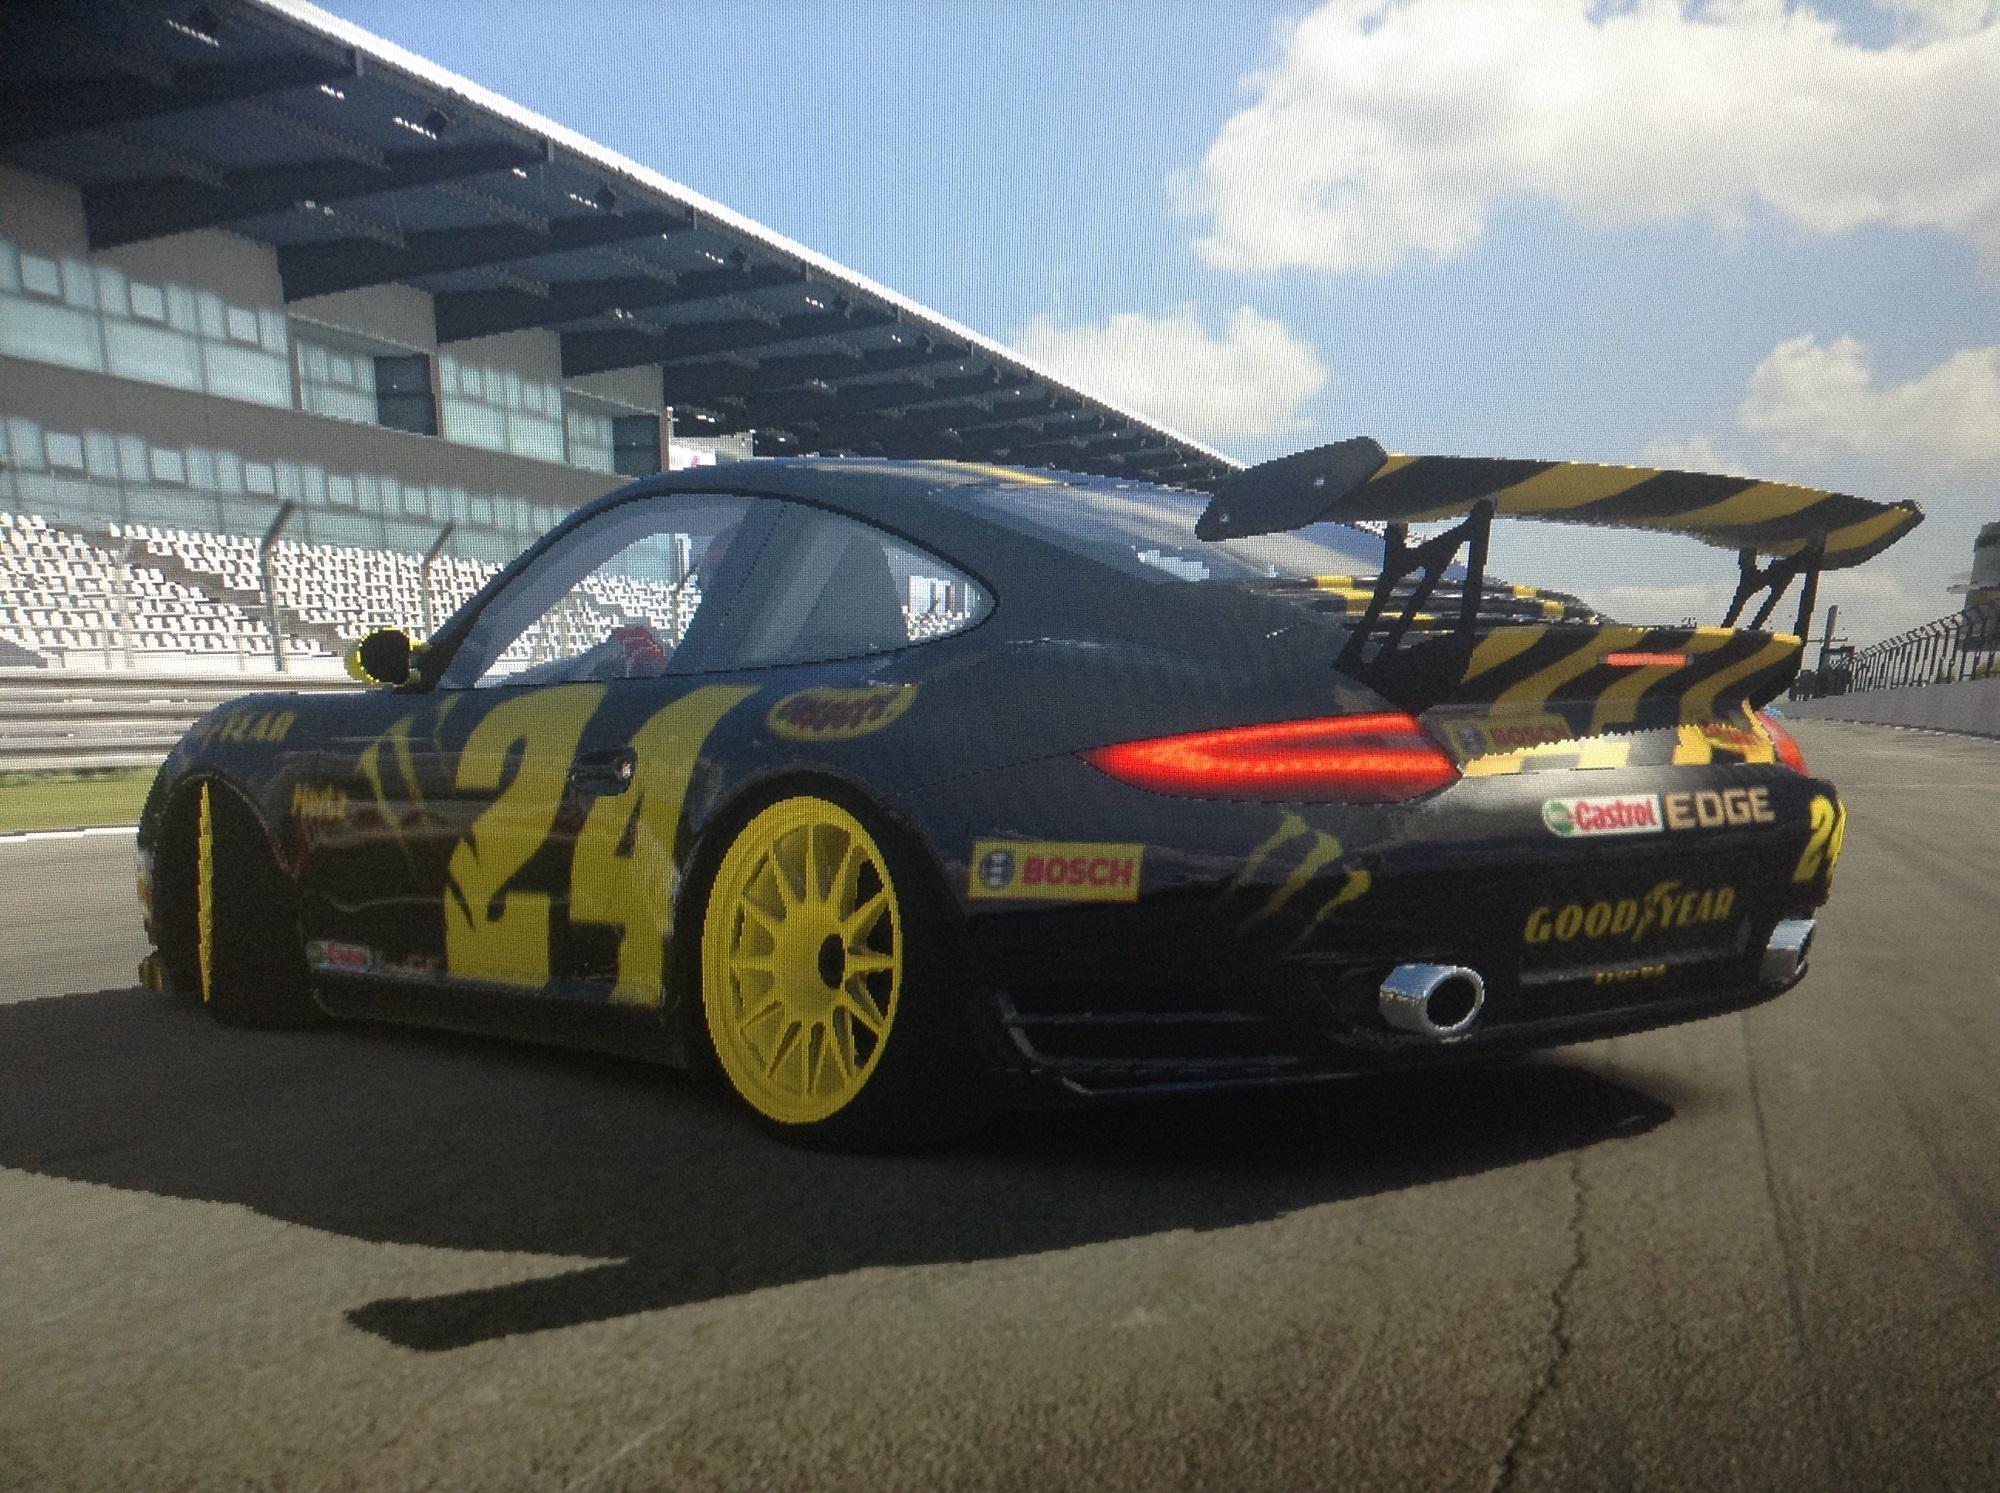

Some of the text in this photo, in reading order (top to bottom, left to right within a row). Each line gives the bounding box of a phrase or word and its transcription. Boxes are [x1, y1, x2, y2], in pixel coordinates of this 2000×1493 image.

[1574, 786, 1776, 832] Castrol EDGE
[444, 682, 762, 1010] 24
[1023, 856, 1133, 887] BOSCH
[1524, 879, 1736, 943] GOODYEAR
